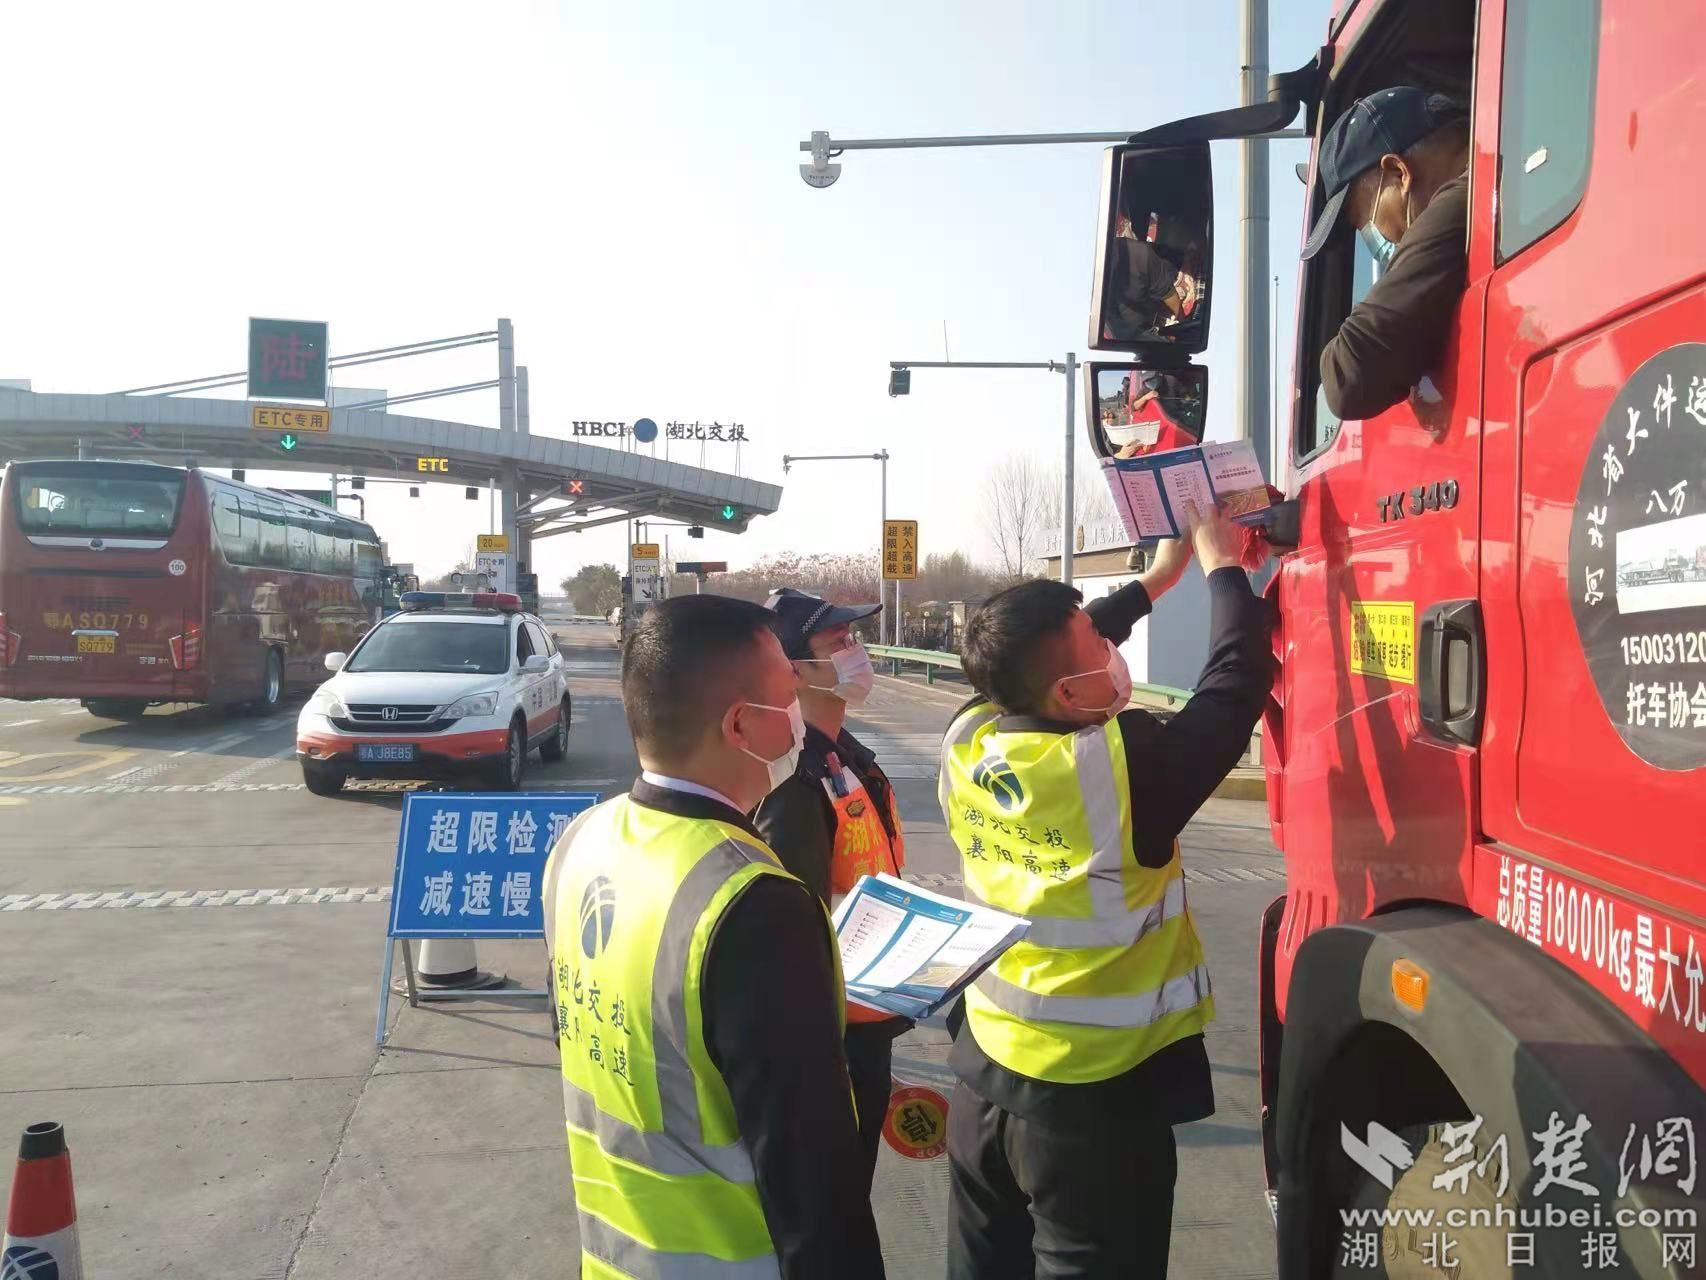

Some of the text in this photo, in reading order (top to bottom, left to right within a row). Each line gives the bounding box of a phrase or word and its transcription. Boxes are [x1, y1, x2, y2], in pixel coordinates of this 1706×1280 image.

[258, 411, 323, 428] ETC专用
[572, 421, 626, 437] HBCI
[666, 420, 750, 442] 湖北交投
[418, 457, 449, 472] ETC
[1377, 479, 1460, 523] TK 340
[1646, 479, 1688, 516] 八万
[482, 538, 493, 548] 20
[887, 526, 898, 574] 超限超载
[902, 526, 914, 575] 禁入高速
[43, 611, 149, 630] ASQ779
[1626, 681, 1706, 728] 托车协会
[361, 746, 412, 760] AJ8E85
[964, 804, 1071, 850] 湖北交投
[966, 833, 1071, 882] 襄阳高速
[419, 870, 544, 917] 减速慢
